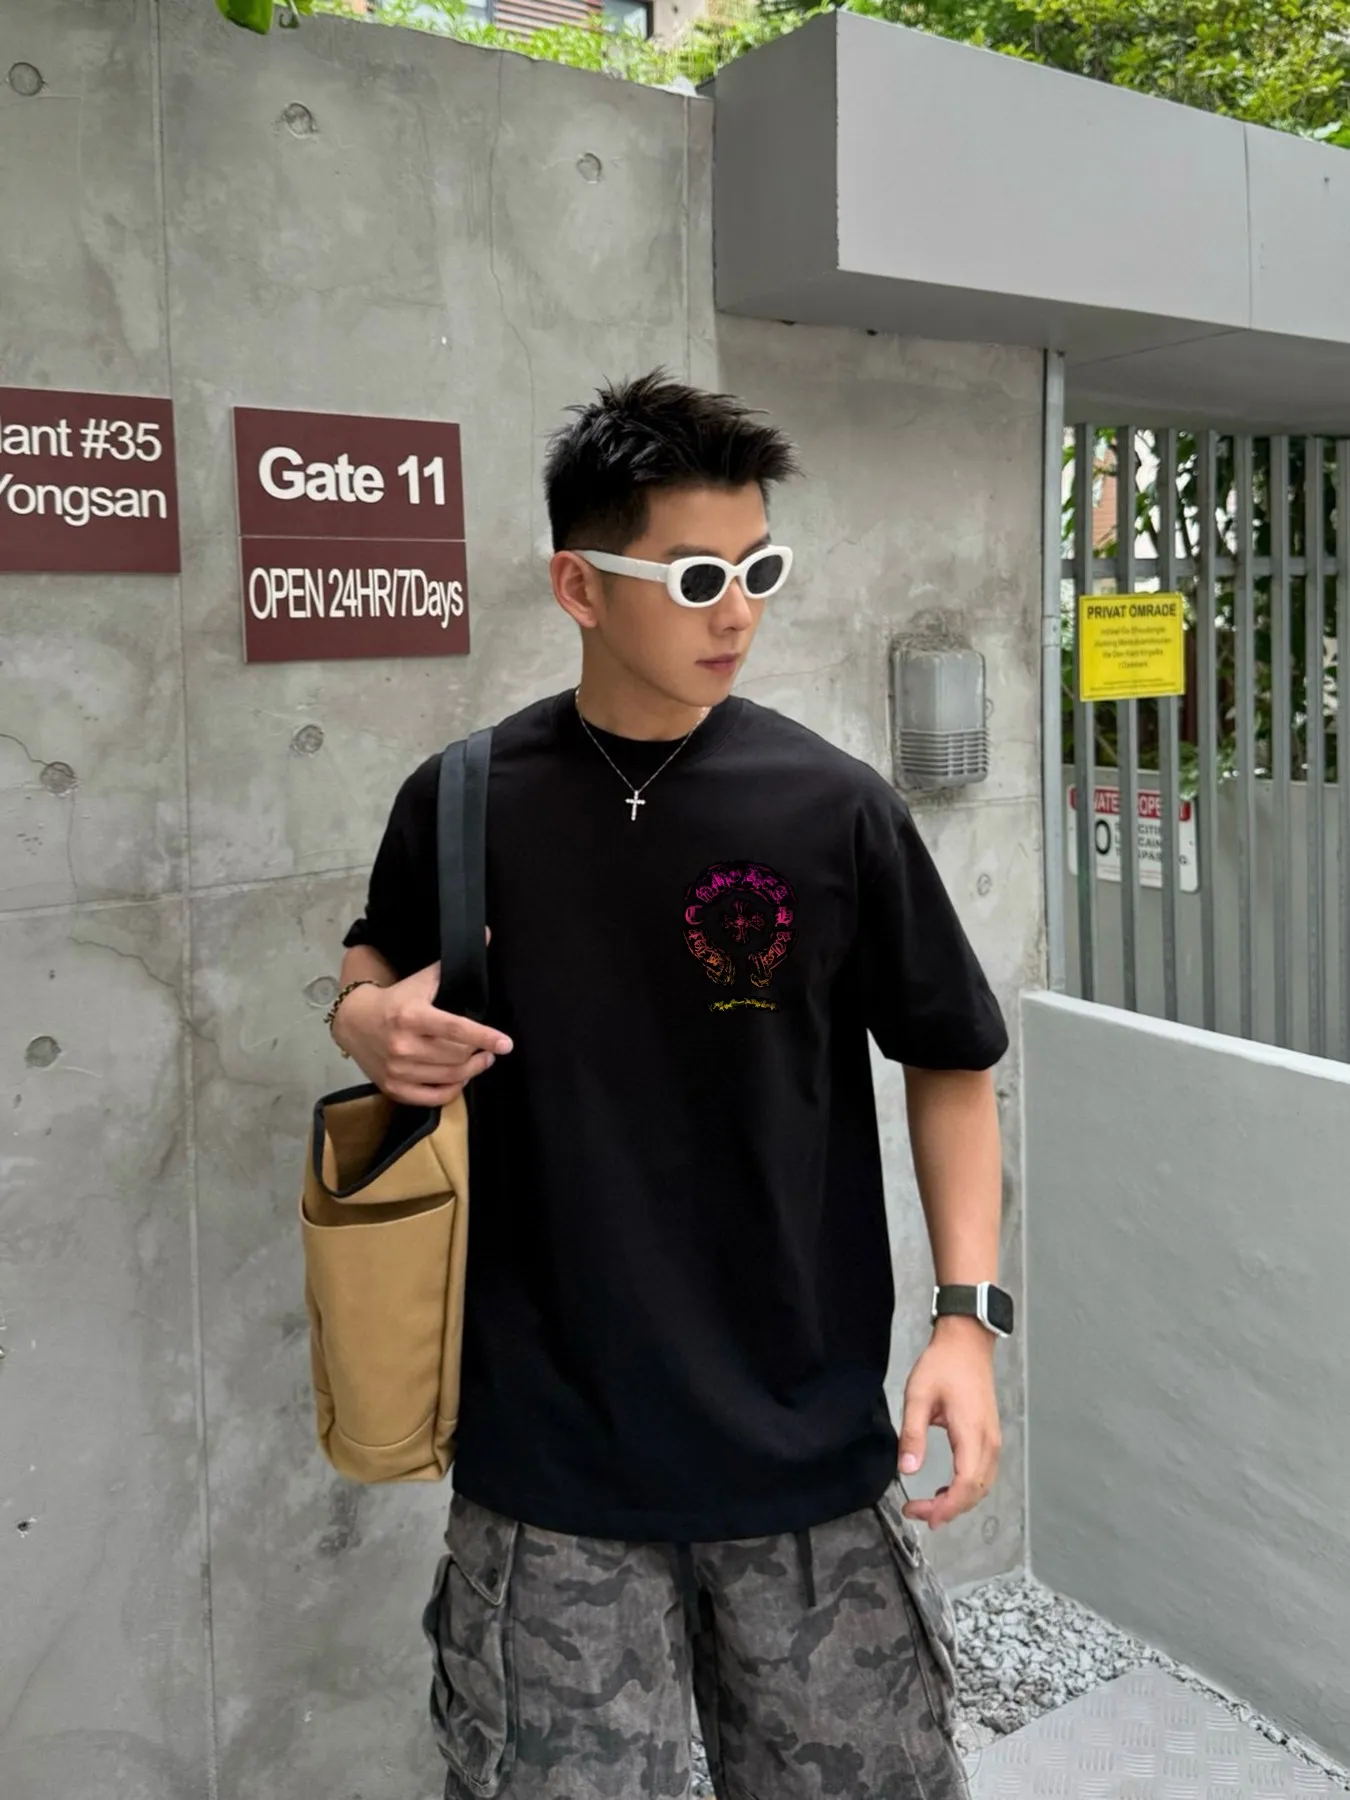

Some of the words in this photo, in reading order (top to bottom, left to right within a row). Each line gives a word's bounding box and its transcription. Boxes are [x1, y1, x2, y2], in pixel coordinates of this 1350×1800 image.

[0, 420, 73, 456] ant
[80, 419, 161, 461] #35
[259, 447, 384, 502] Gate
[398, 456, 444, 505] 11
[250, 568, 324, 619] OPEN
[1087, 605, 1127, 620] PRIVAT
